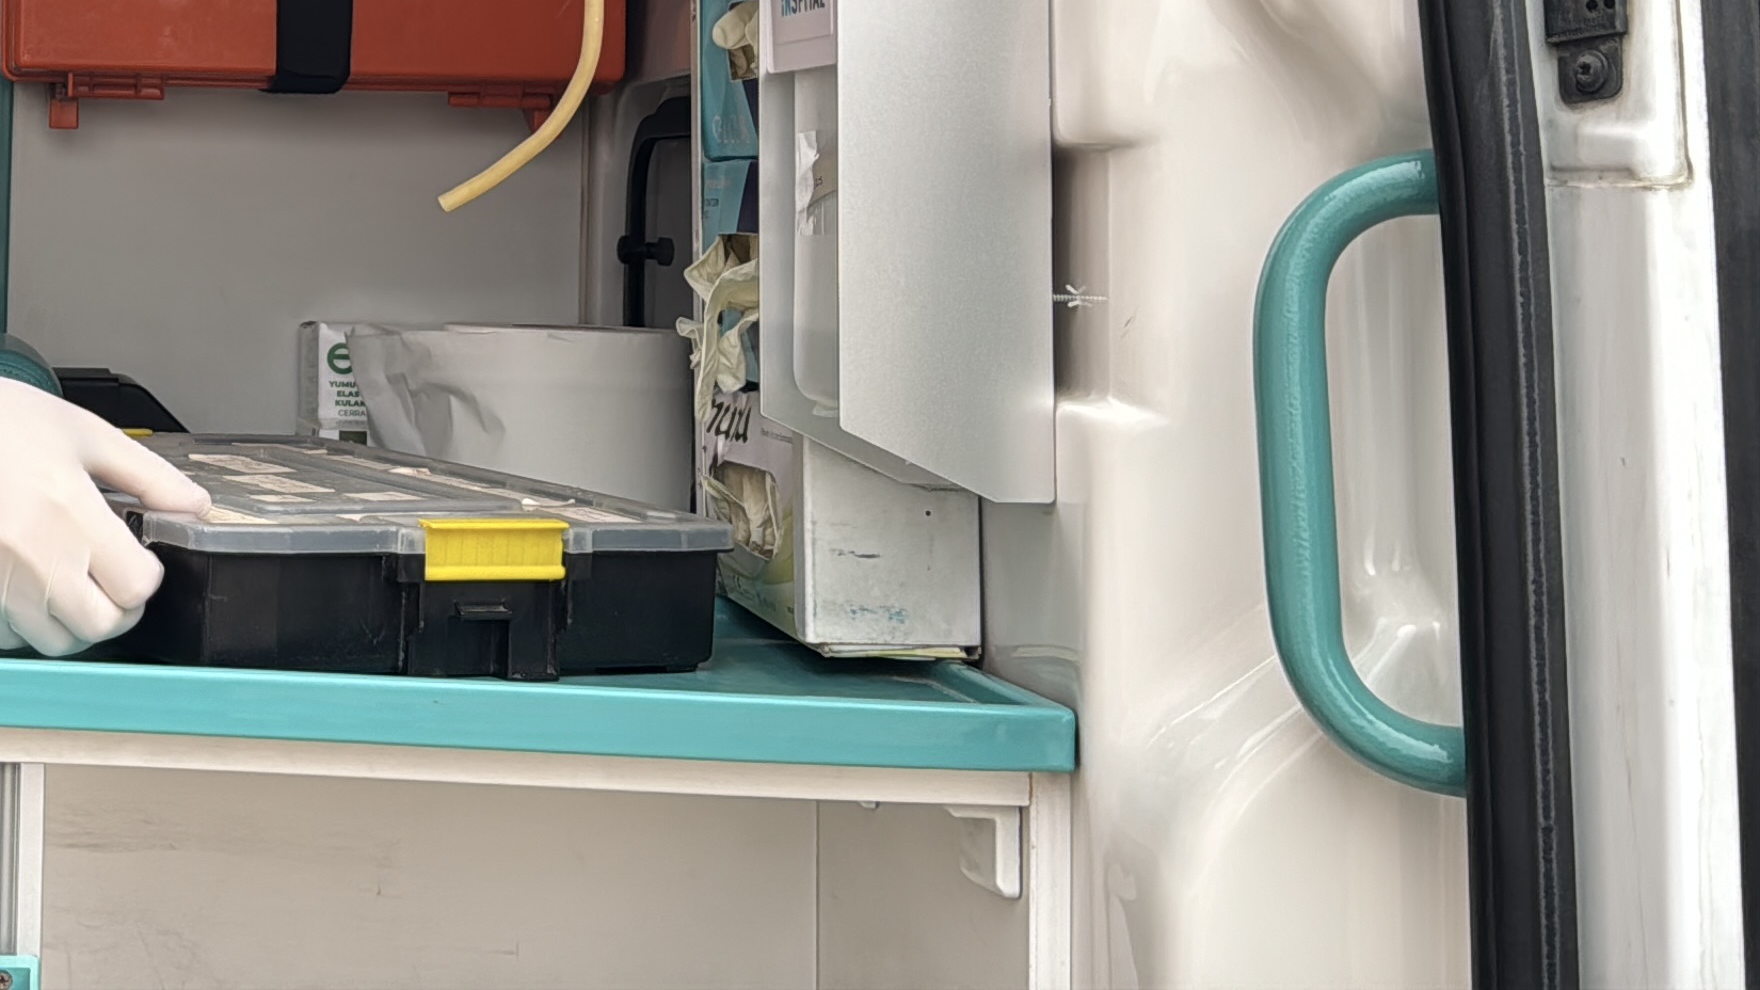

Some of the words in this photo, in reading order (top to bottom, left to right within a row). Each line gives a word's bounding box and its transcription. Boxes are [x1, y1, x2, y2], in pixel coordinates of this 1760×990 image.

[328, 381, 357, 389] YUMU
[336, 390, 361, 398] ELAS
[337, 409, 367, 417] CERRA
